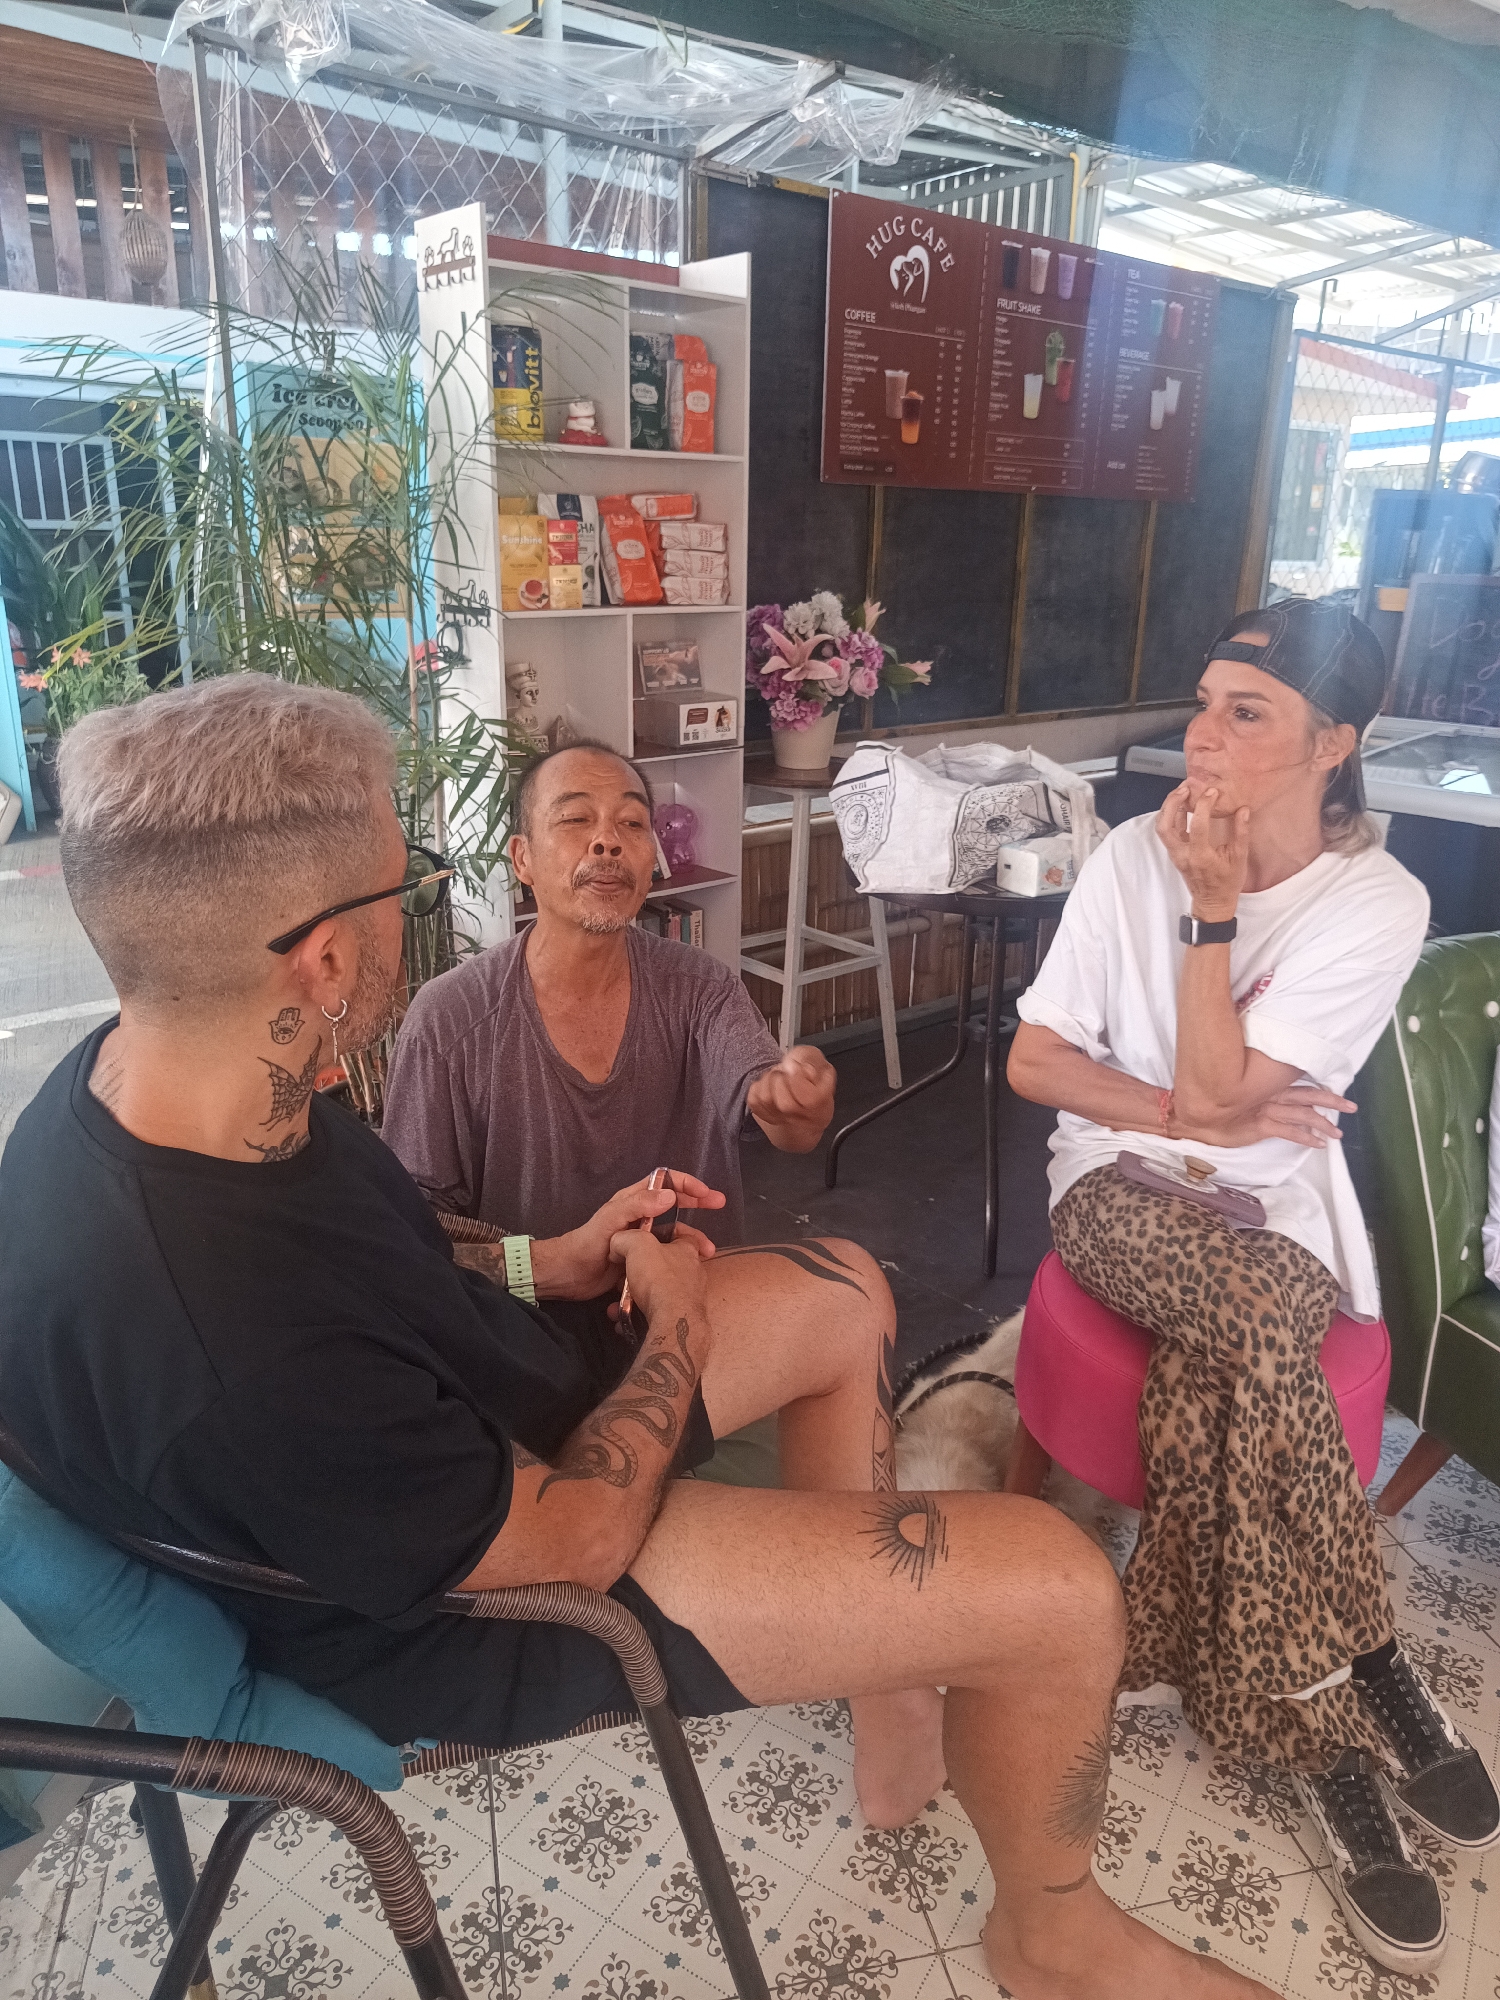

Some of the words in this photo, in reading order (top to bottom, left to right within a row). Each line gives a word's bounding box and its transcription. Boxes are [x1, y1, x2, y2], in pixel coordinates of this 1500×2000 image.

[865, 216, 906, 259] HUG
[911, 218, 955, 272] CAFE
[997, 298, 1017, 310] FRUIT
[1018, 302, 1042, 315] SHAKE
[845, 308, 876, 323] COFFEE
[272, 383, 307, 405] Ice
[315, 390, 383, 413] crea
[502, 534, 543, 545] Sunshine
